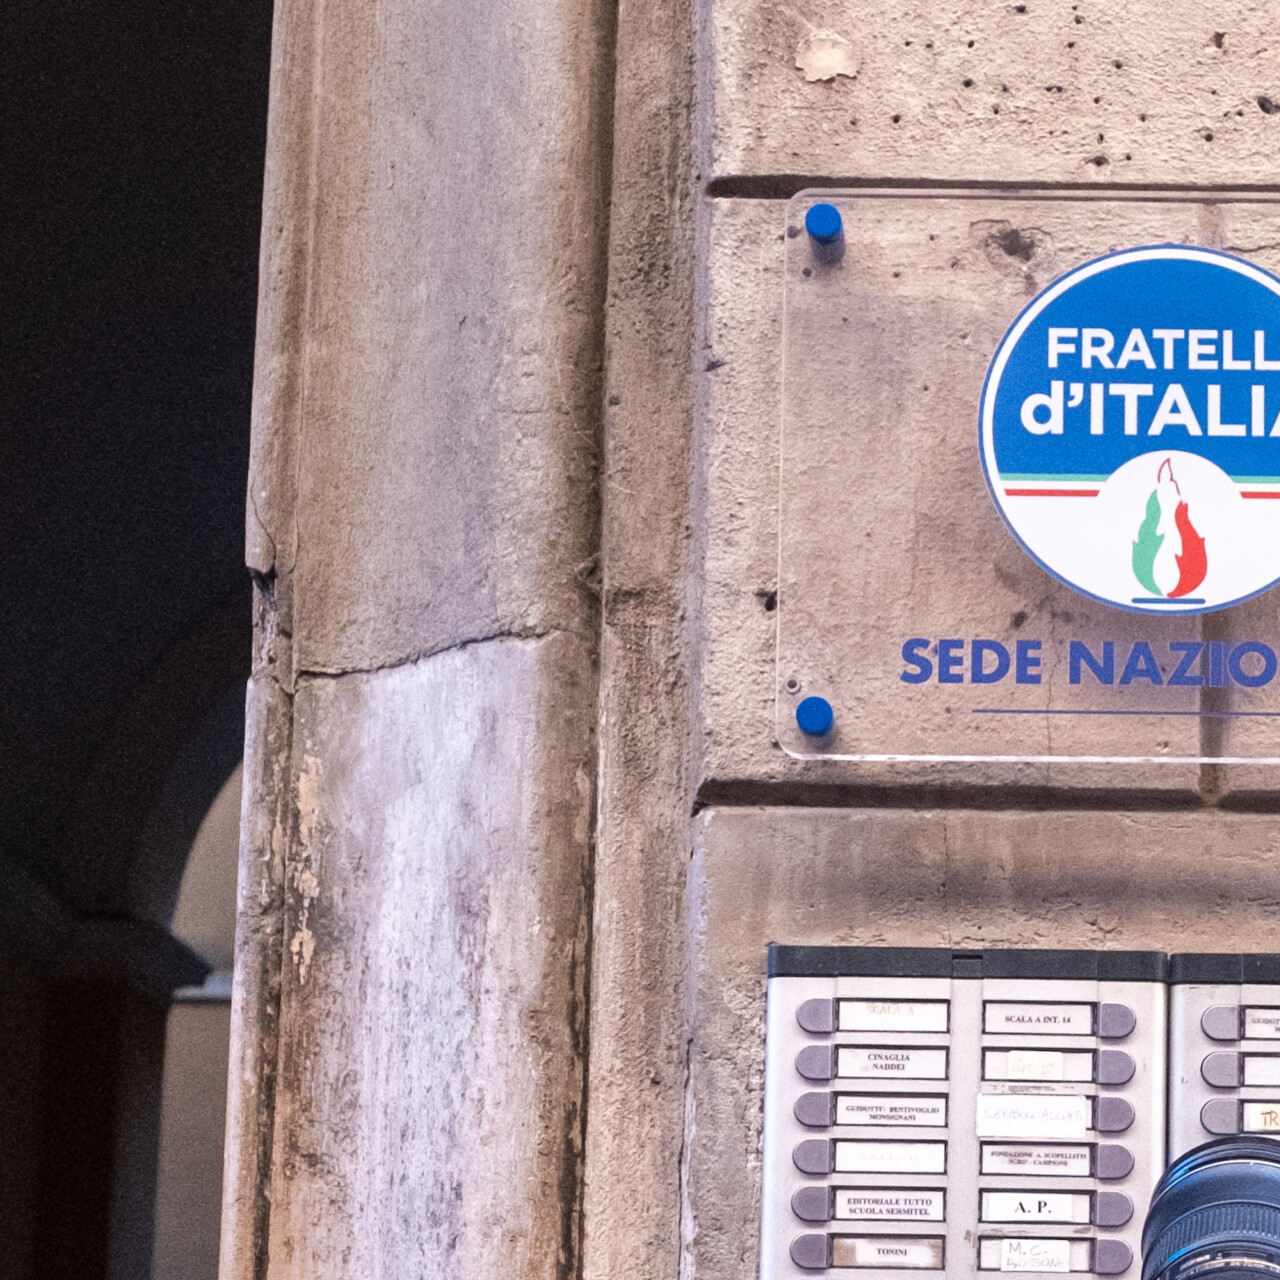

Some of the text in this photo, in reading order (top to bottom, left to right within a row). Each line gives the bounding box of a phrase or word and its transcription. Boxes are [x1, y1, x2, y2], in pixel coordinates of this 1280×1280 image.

[900, 638, 1042, 684] SEDE
[1043, 1016, 1061, 1024] INT.
[1062, 1016, 1071, 1024] 14
[868, 1053, 910, 1061] CINAGLIA
[847, 1198, 901, 1206] EDITORIALE
[1014, 1201, 1052, 1214] A. P.
[886, 1208, 931, 1216] SERMITEL
[877, 1248, 907, 1256] TONINI
